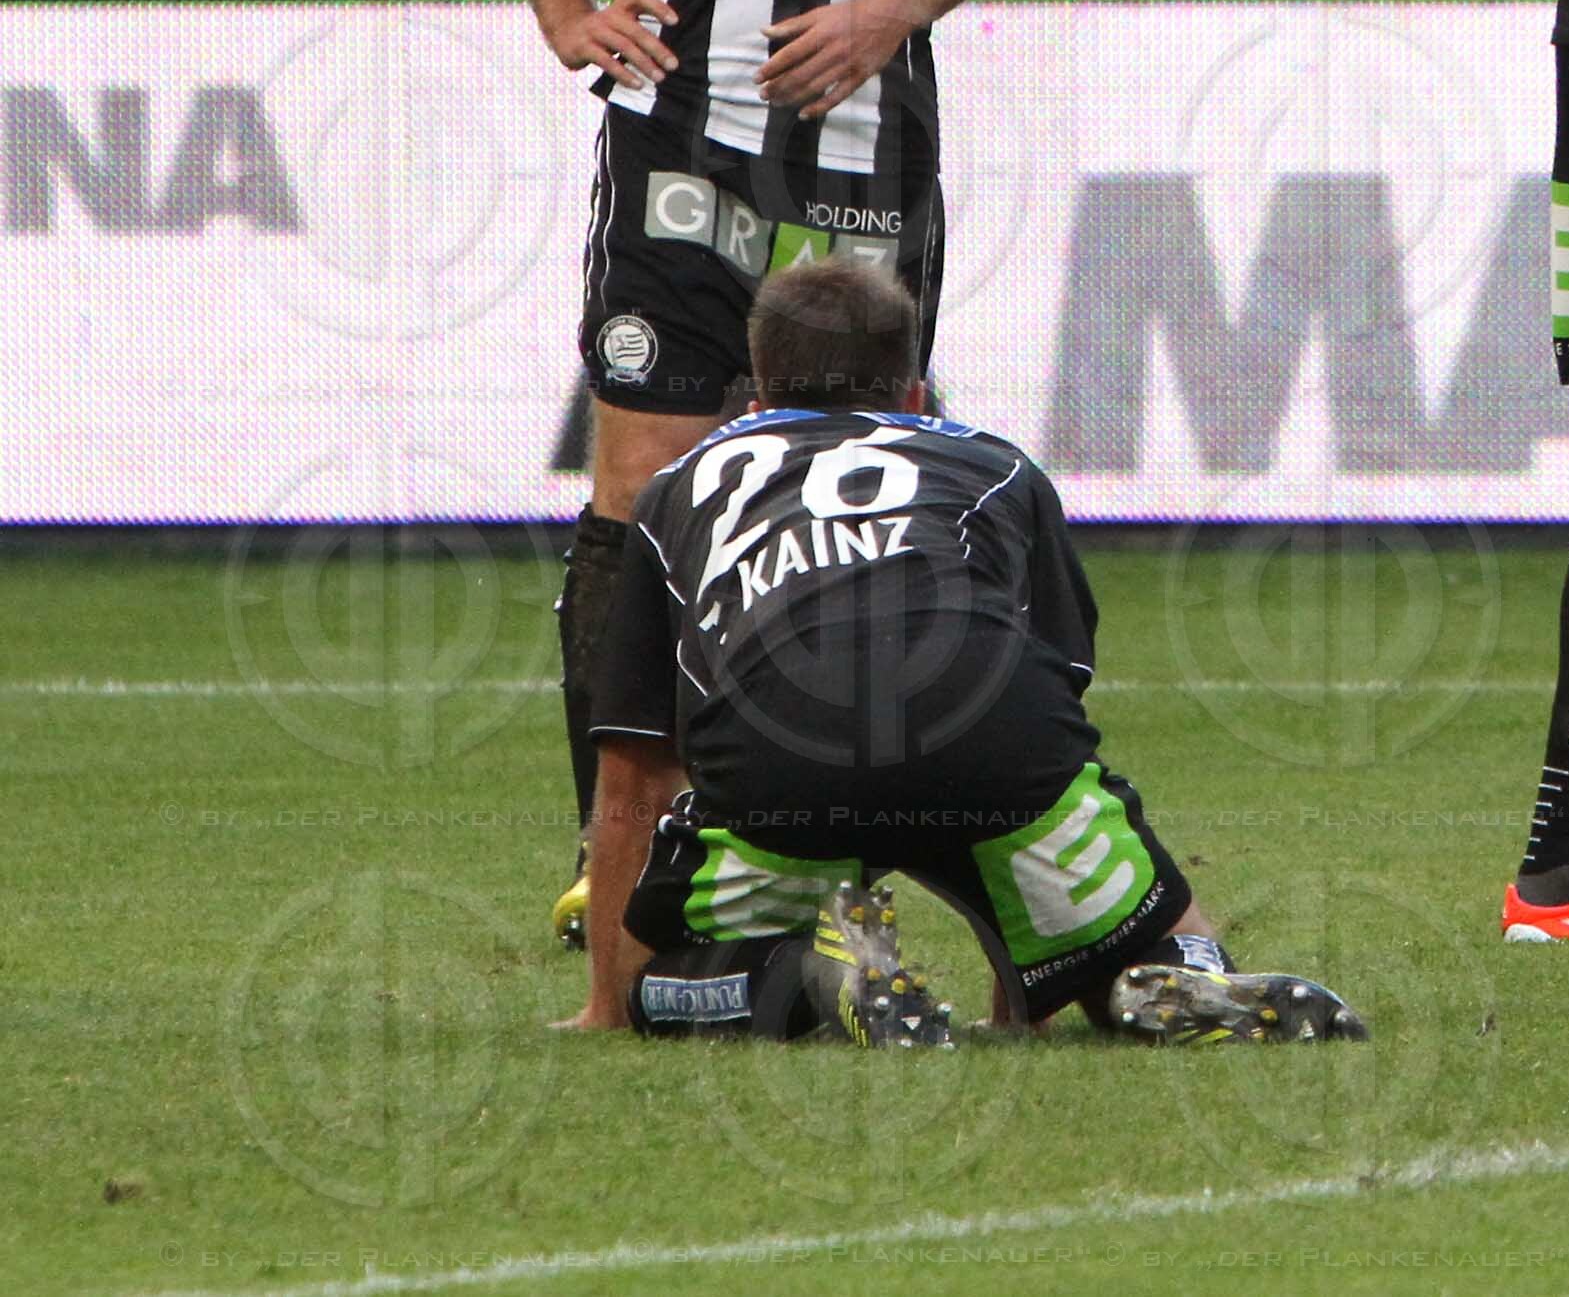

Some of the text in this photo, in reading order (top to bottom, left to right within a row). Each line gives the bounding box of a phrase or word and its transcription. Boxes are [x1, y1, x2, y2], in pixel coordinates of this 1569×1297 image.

[805, 200, 902, 234] HOLDING
[691, 426, 919, 607] 26
[737, 515, 916, 612] KAINZ
